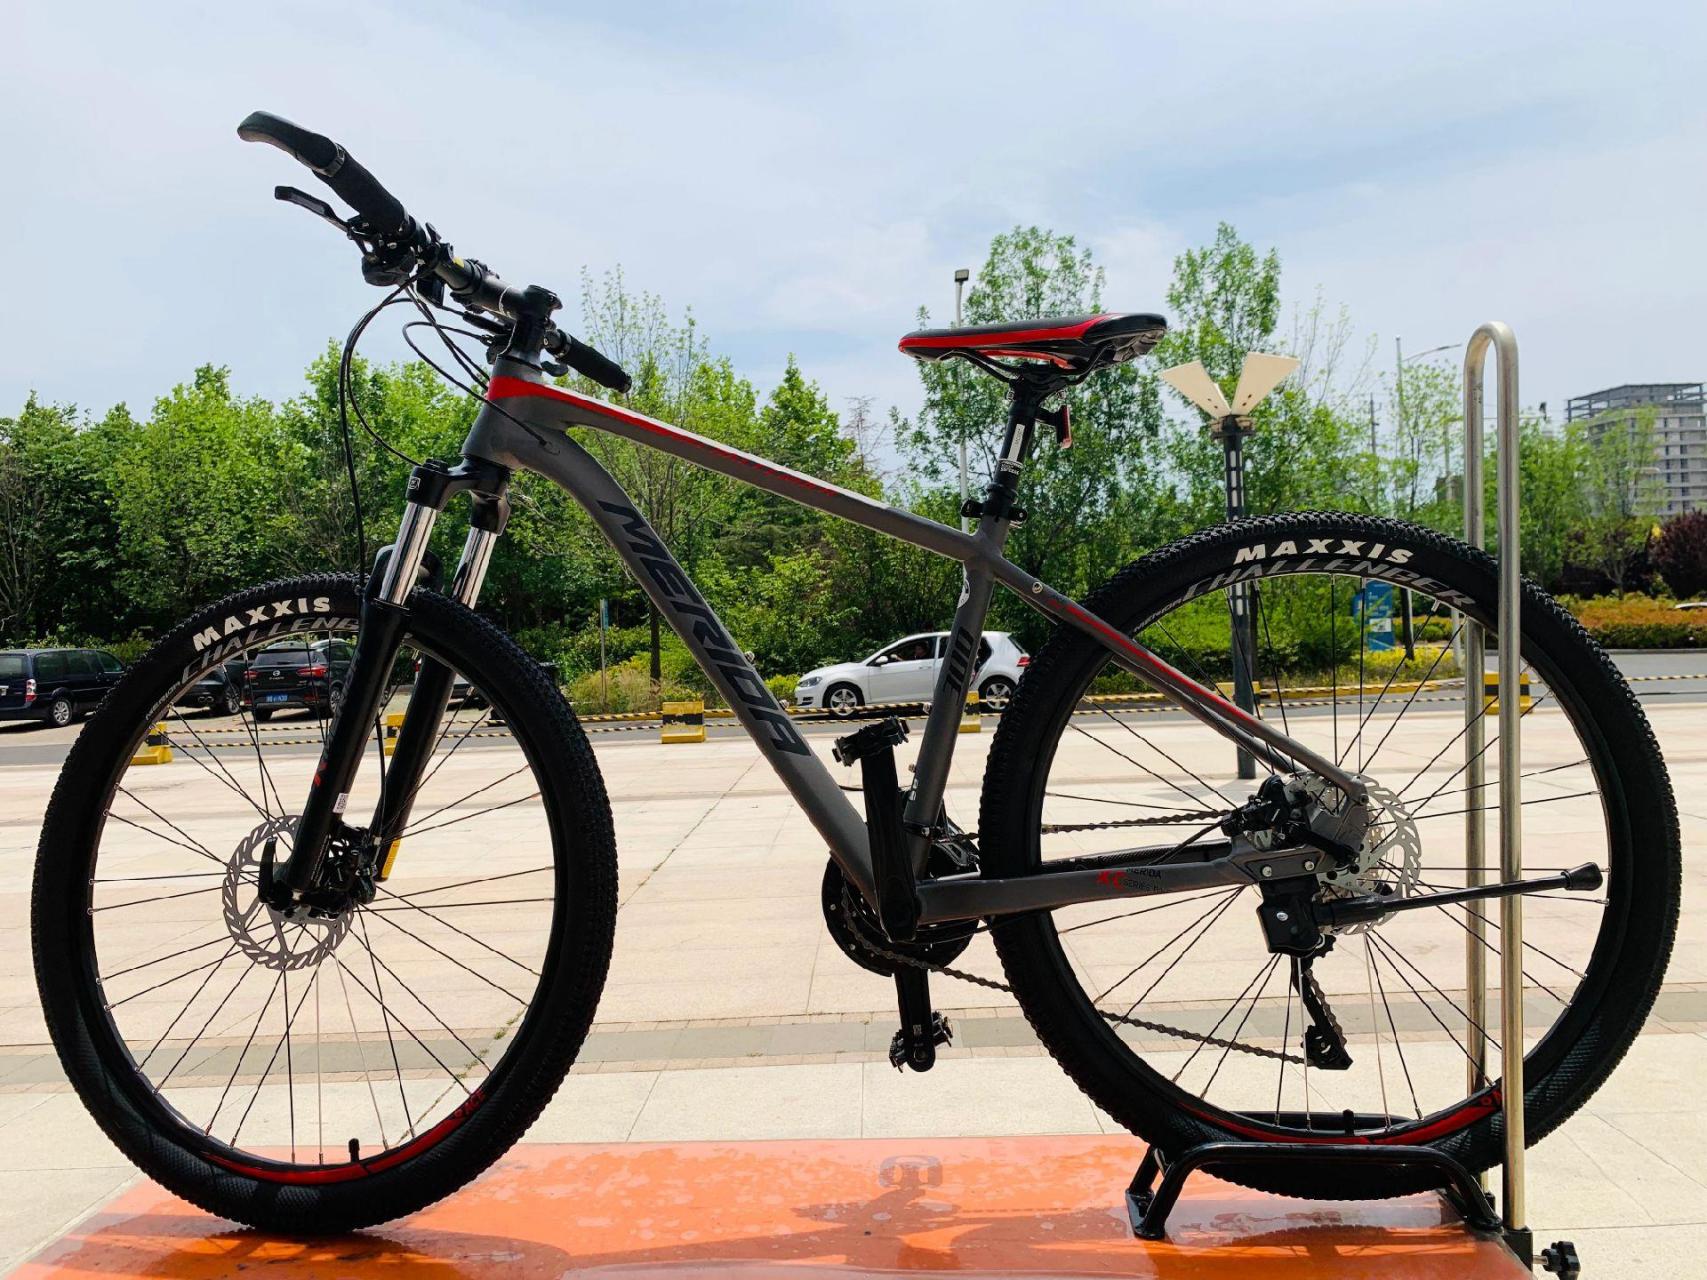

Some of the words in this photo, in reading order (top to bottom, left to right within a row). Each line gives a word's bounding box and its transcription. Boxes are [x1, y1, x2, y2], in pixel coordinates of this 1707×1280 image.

[1234, 539, 1414, 565] MAXXIS
[181, 617, 360, 684] CHALLENG
[192, 597, 330, 651] MAXXIS
[597, 500, 812, 757] MERIDA
